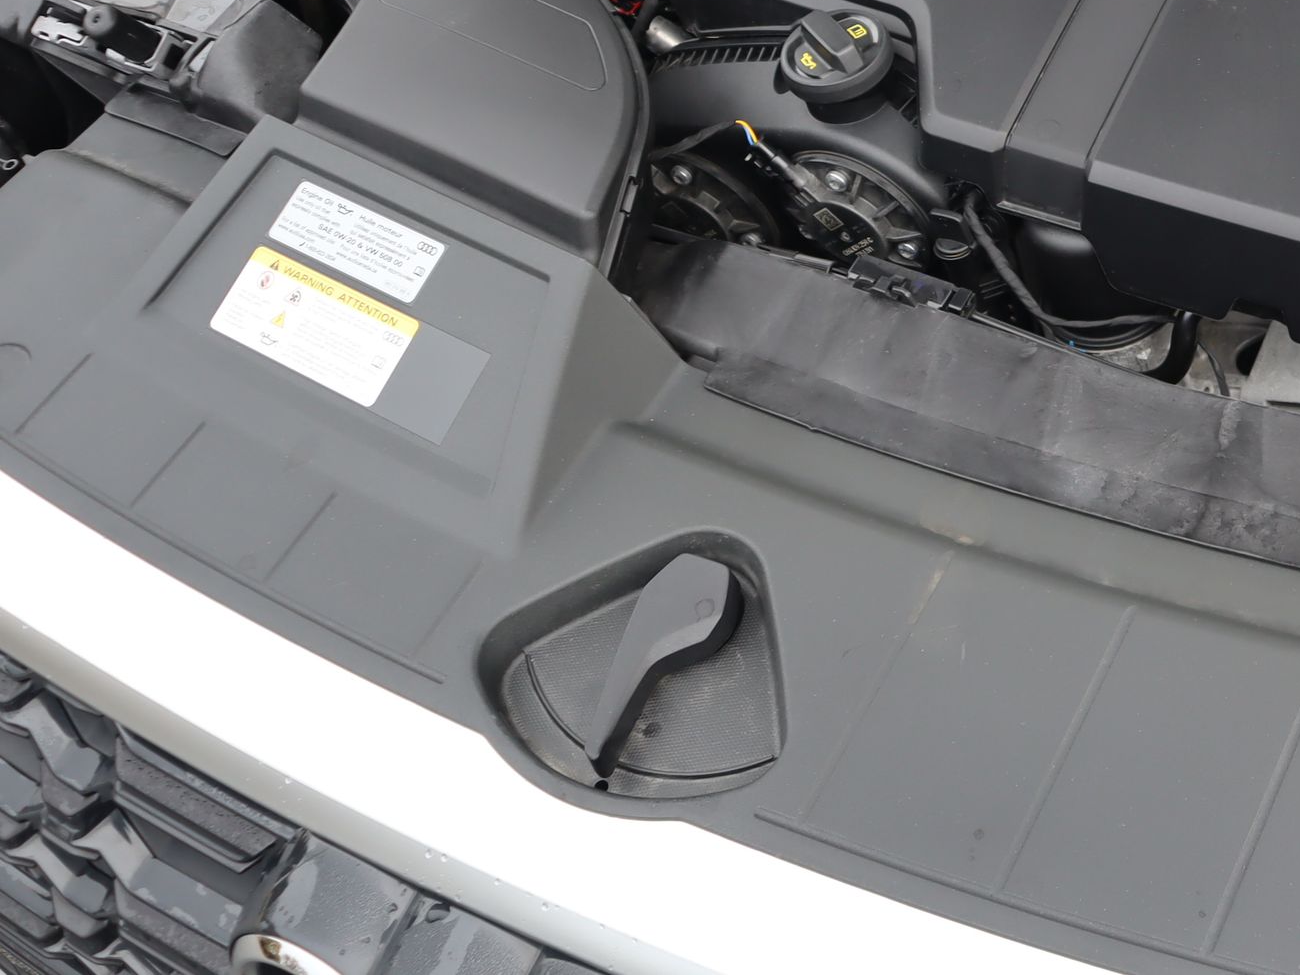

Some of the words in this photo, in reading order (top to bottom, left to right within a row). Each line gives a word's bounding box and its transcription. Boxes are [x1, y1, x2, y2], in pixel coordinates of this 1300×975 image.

[301, 187, 324, 203] Engine
[324, 197, 335, 207] Oil
[317, 223, 333, 236] SAE
[365, 244, 379, 257] VW
[359, 214, 376, 227] Huile
[376, 222, 404, 239] moteur
[283, 264, 335, 297] WARNING
[338, 292, 399, 327] ATTENTION
